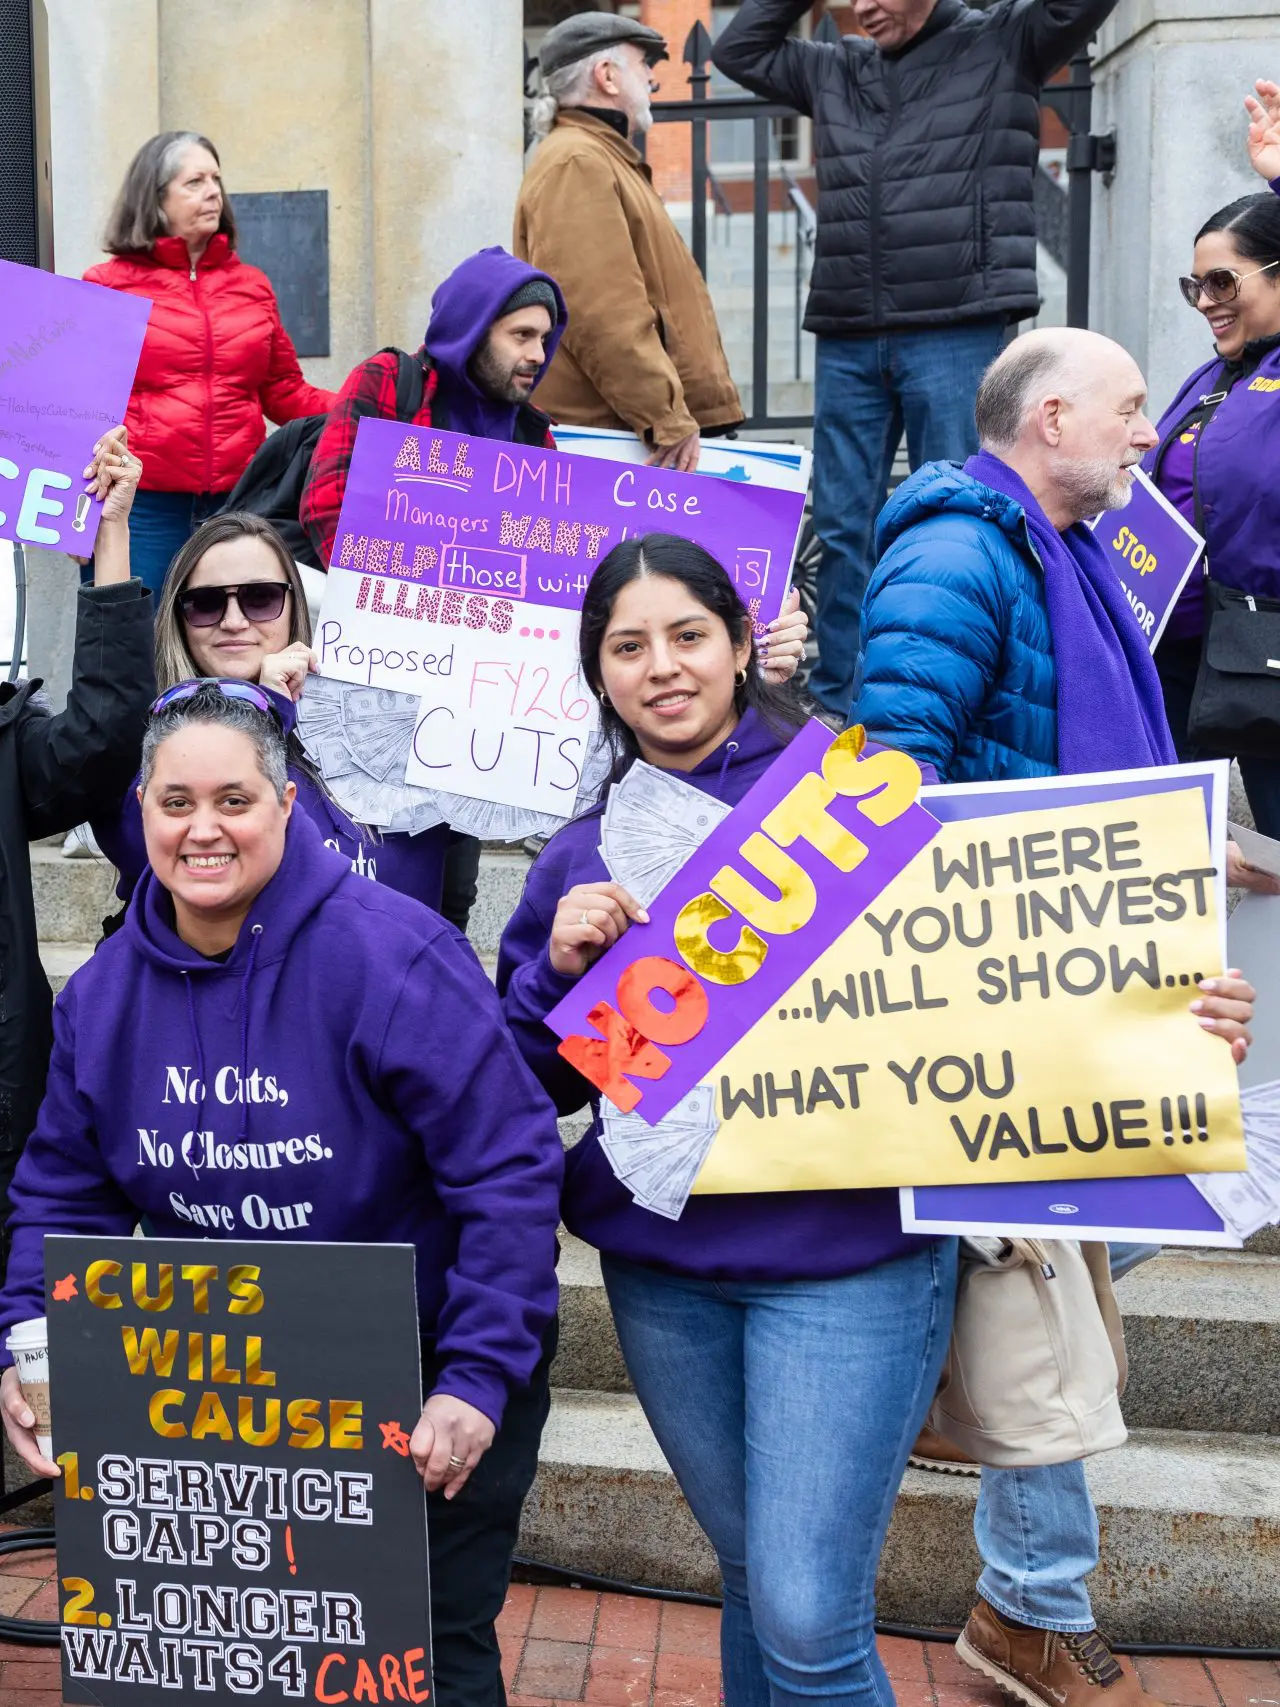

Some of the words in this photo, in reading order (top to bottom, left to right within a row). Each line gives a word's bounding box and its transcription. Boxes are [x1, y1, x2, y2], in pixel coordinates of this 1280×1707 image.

[394, 436, 475, 480] ALL
[493, 452, 571, 506] DMH
[612, 471, 702, 515] Case
[385, 488, 489, 546] Managers
[499, 511, 609, 559] WANT
[1112, 526, 1157, 577] STOP
[339, 533, 438, 578] HELP
[447, 550, 520, 590] those
[321, 620, 455, 684] Proposed
[468, 661, 589, 721] FY26
[413, 706, 581, 791] CUTS
[932, 821, 1142, 893] WHERE
[557, 956, 709, 1114] NO
[673, 723, 922, 986] CUTS
[864, 899, 992, 957] YOU
[1016, 867, 1218, 940] INVEST
[161, 1066, 206, 1105] No
[215, 1065, 289, 1107] Cuts,
[720, 1062, 869, 1120] WHAT
[887, 1050, 1015, 1105] YOU
[136, 1128, 175, 1168] No
[181, 1132, 333, 1170] Closures.
[169, 1191, 235, 1231] Save
[241, 1194, 313, 1231] Our
[85, 1259, 265, 1315] CUTS
[120, 1326, 277, 1387] WILL
[148, 1388, 365, 1451] CAUSE
[96, 1454, 375, 1526] SERVICE
[115, 1578, 367, 1646] LONGER
[313, 1647, 430, 1705] CARE
